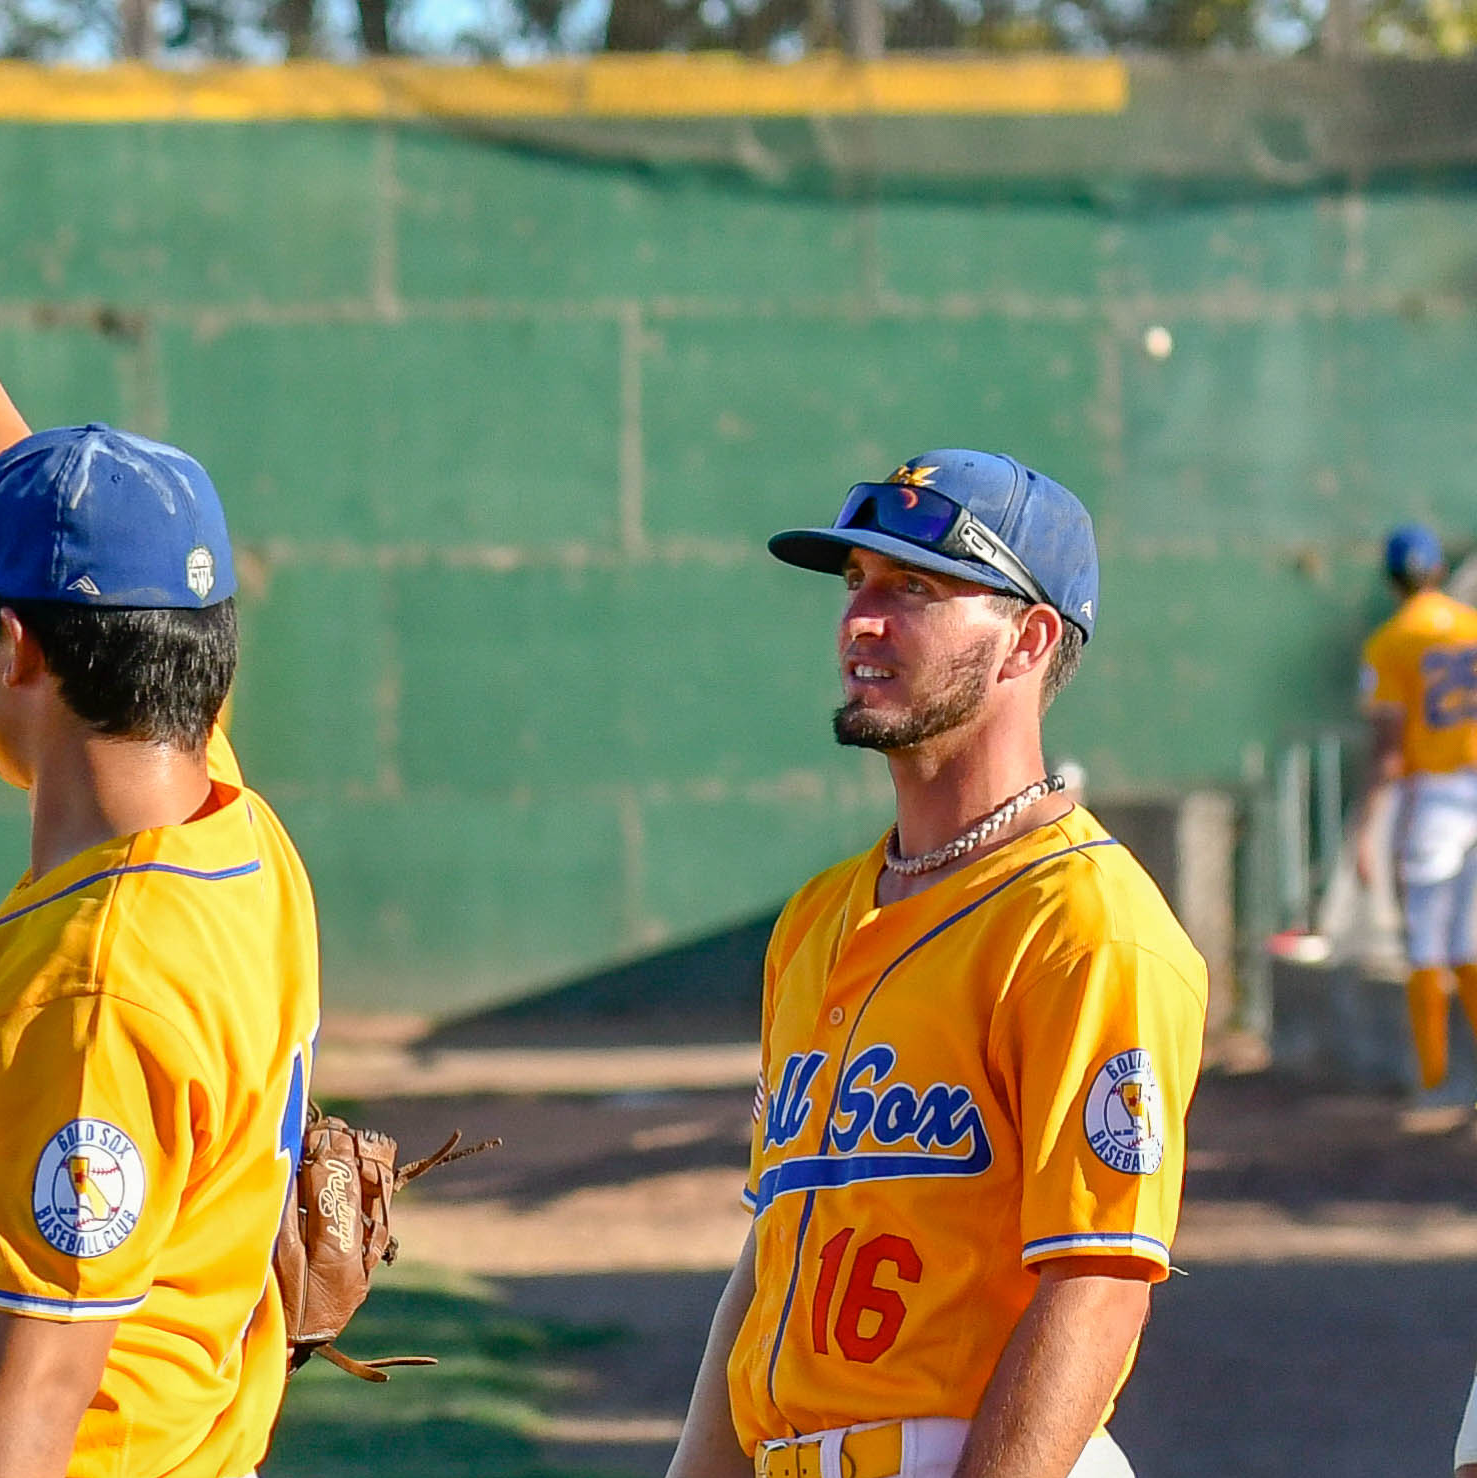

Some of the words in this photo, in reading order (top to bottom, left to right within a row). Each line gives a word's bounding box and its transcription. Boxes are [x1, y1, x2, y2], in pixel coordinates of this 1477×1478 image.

[56, 1122, 95, 1153] GOLD
[99, 1127, 133, 1160] SOX
[35, 1206, 102, 1256] BASEBALL
[811, 1227, 924, 1364] 16
